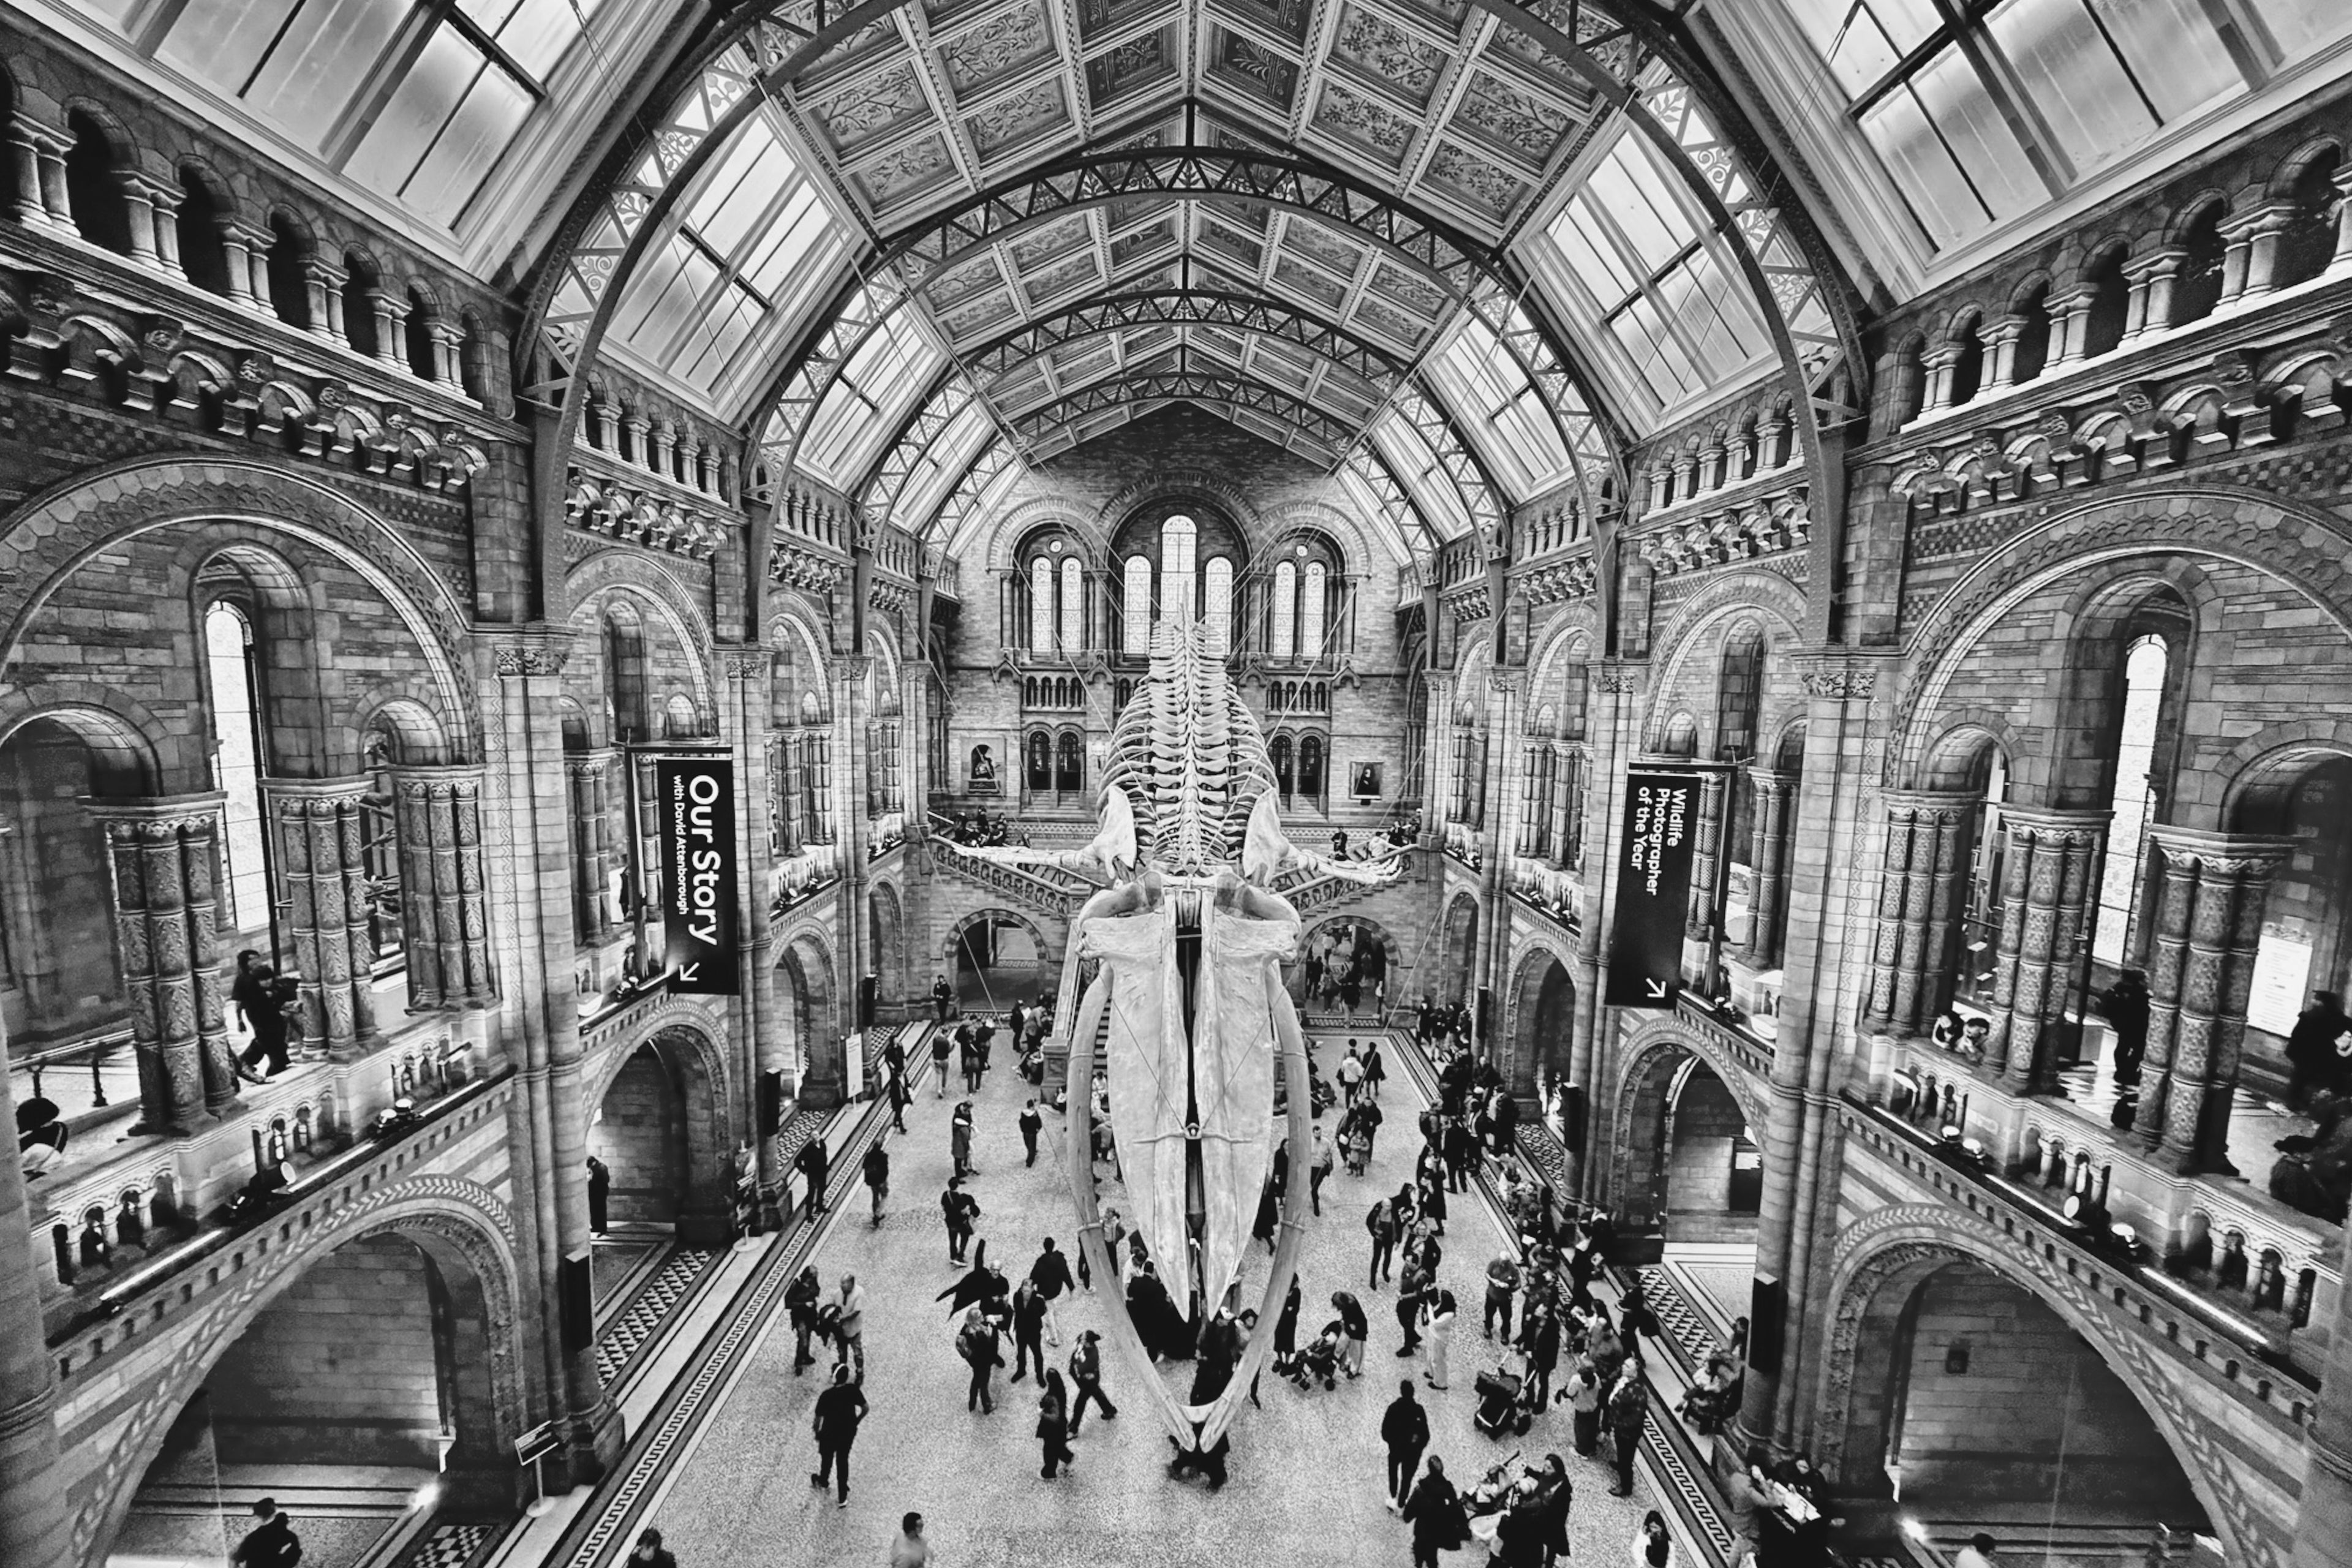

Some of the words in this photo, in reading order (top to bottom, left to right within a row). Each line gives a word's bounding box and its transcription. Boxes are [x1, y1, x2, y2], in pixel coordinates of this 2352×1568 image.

[674, 775, 684, 799] with
[690, 775, 718, 843] Our
[1638, 787, 1653, 805] of
[674, 802, 686, 835] David
[1635, 807, 1650, 832] the
[1667, 788, 1687, 846] Wildlife
[1631, 835, 1648, 870] Year
[1646, 788, 1670, 895] Photographer
[676, 837, 689, 914] Attenborough
[687, 850, 721, 945] Story
